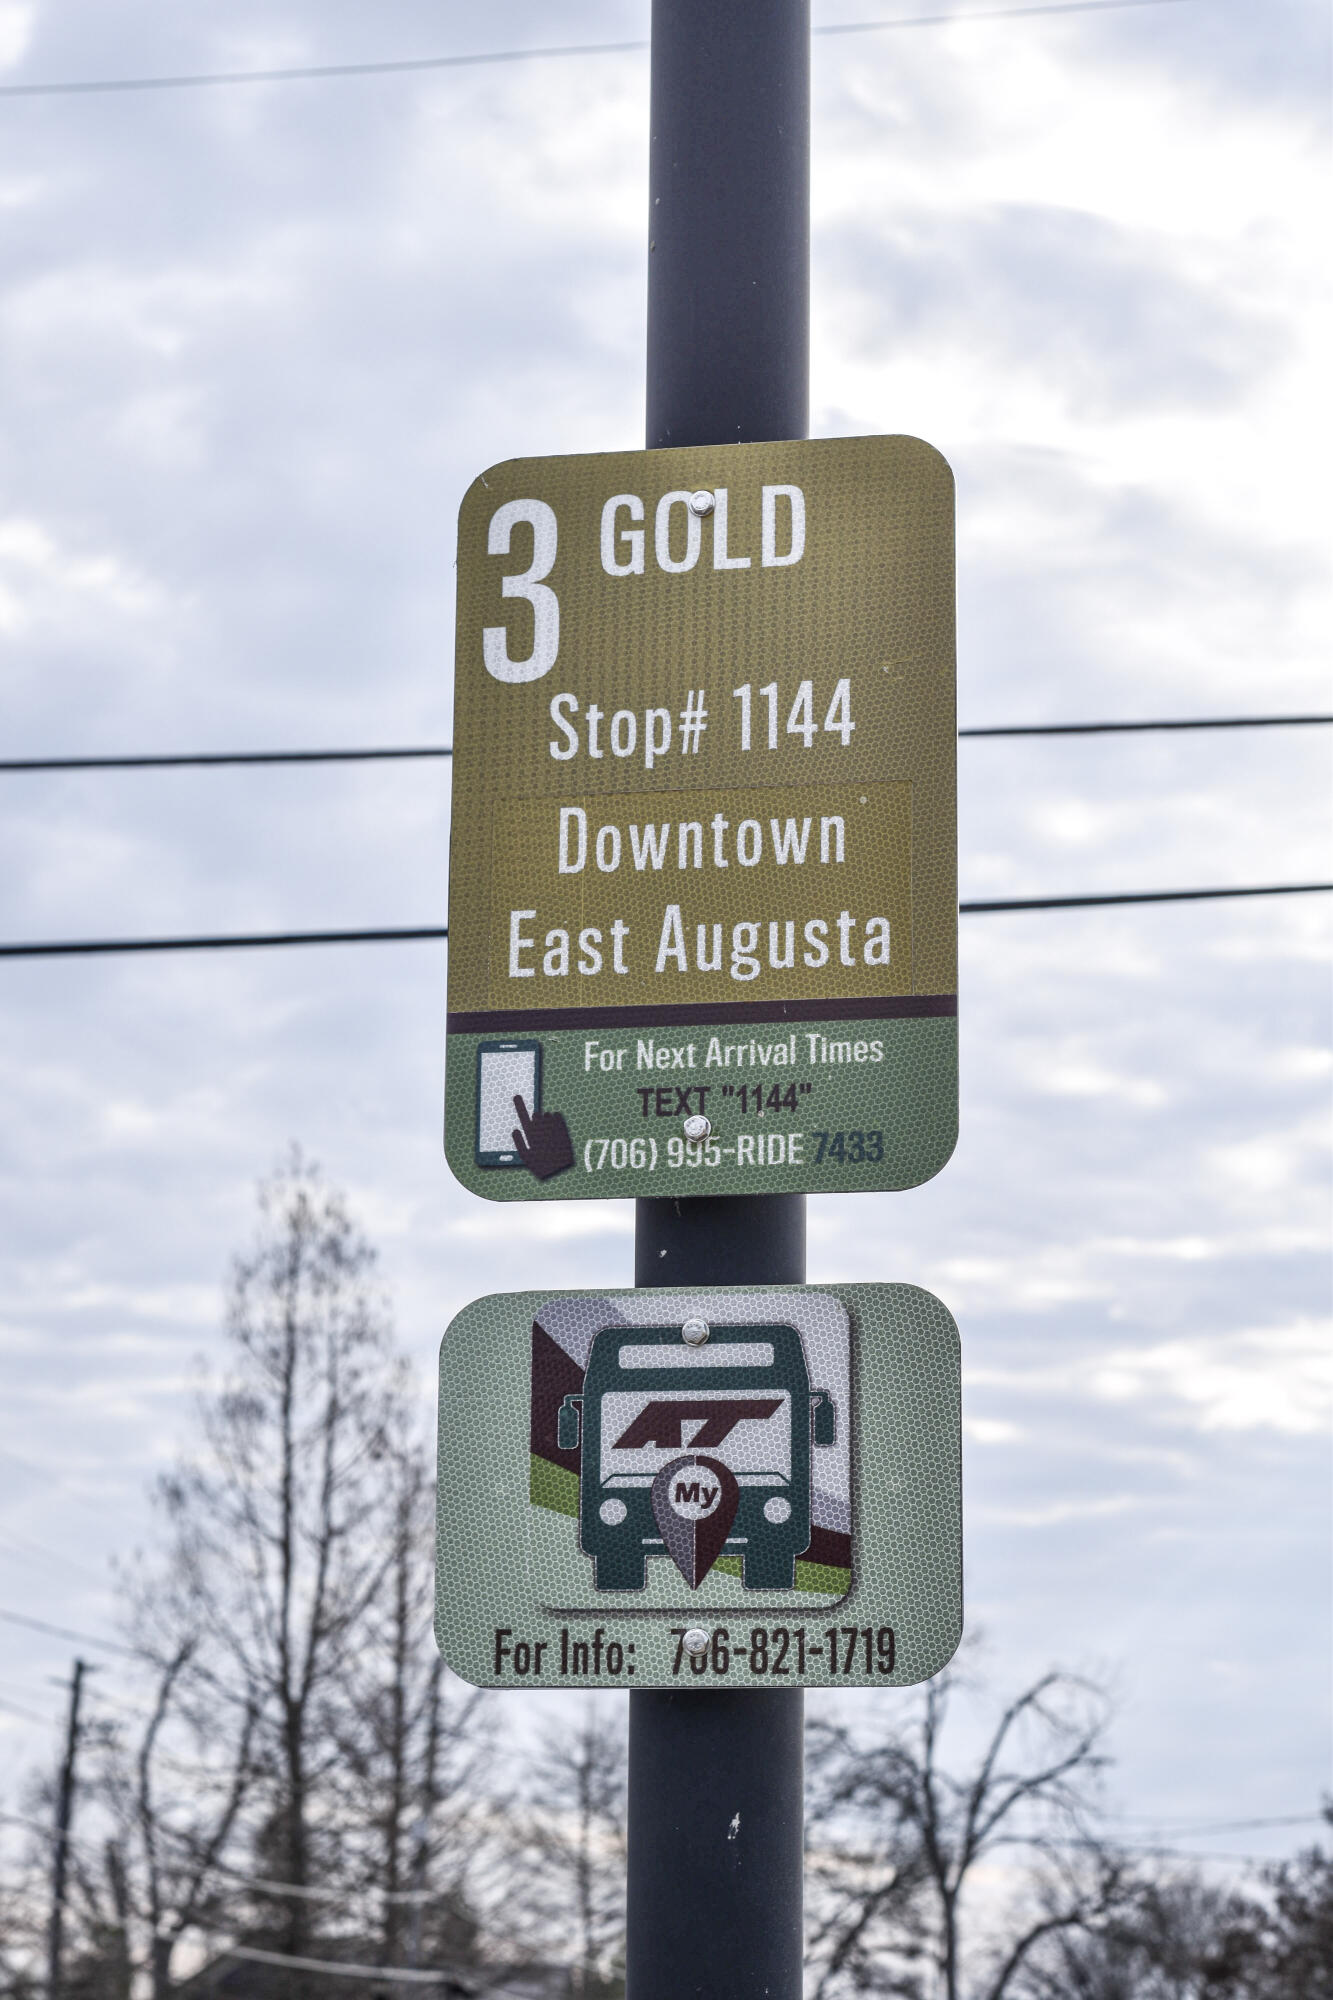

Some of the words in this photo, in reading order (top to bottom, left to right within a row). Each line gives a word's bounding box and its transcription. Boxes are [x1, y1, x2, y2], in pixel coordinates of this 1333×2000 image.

[599, 484, 807, 577] GOLD
[482, 498, 560, 683] 3
[548, 689, 709, 769] Stop#
[732, 678, 856, 751] 1144
[558, 806, 846, 874] Downtown
[508, 909, 630, 978] East
[654, 904, 892, 981] Augusta
[584, 1041, 627, 1072] For
[636, 1039, 697, 1071] Next
[704, 1035, 796, 1068] Arrival
[807, 1033, 884, 1065] Times
[637, 1085, 711, 1117] TEXT
[722, 1082, 813, 1115] "1144"
[584, 1137, 658, 1172] (706)
[667, 1134, 804, 1169] 995-RIDE
[812, 1129, 884, 1164] 7433
[675, 1482, 720, 1510] My
[493, 1629, 548, 1676] For
[561, 1629, 636, 1675] Info:
